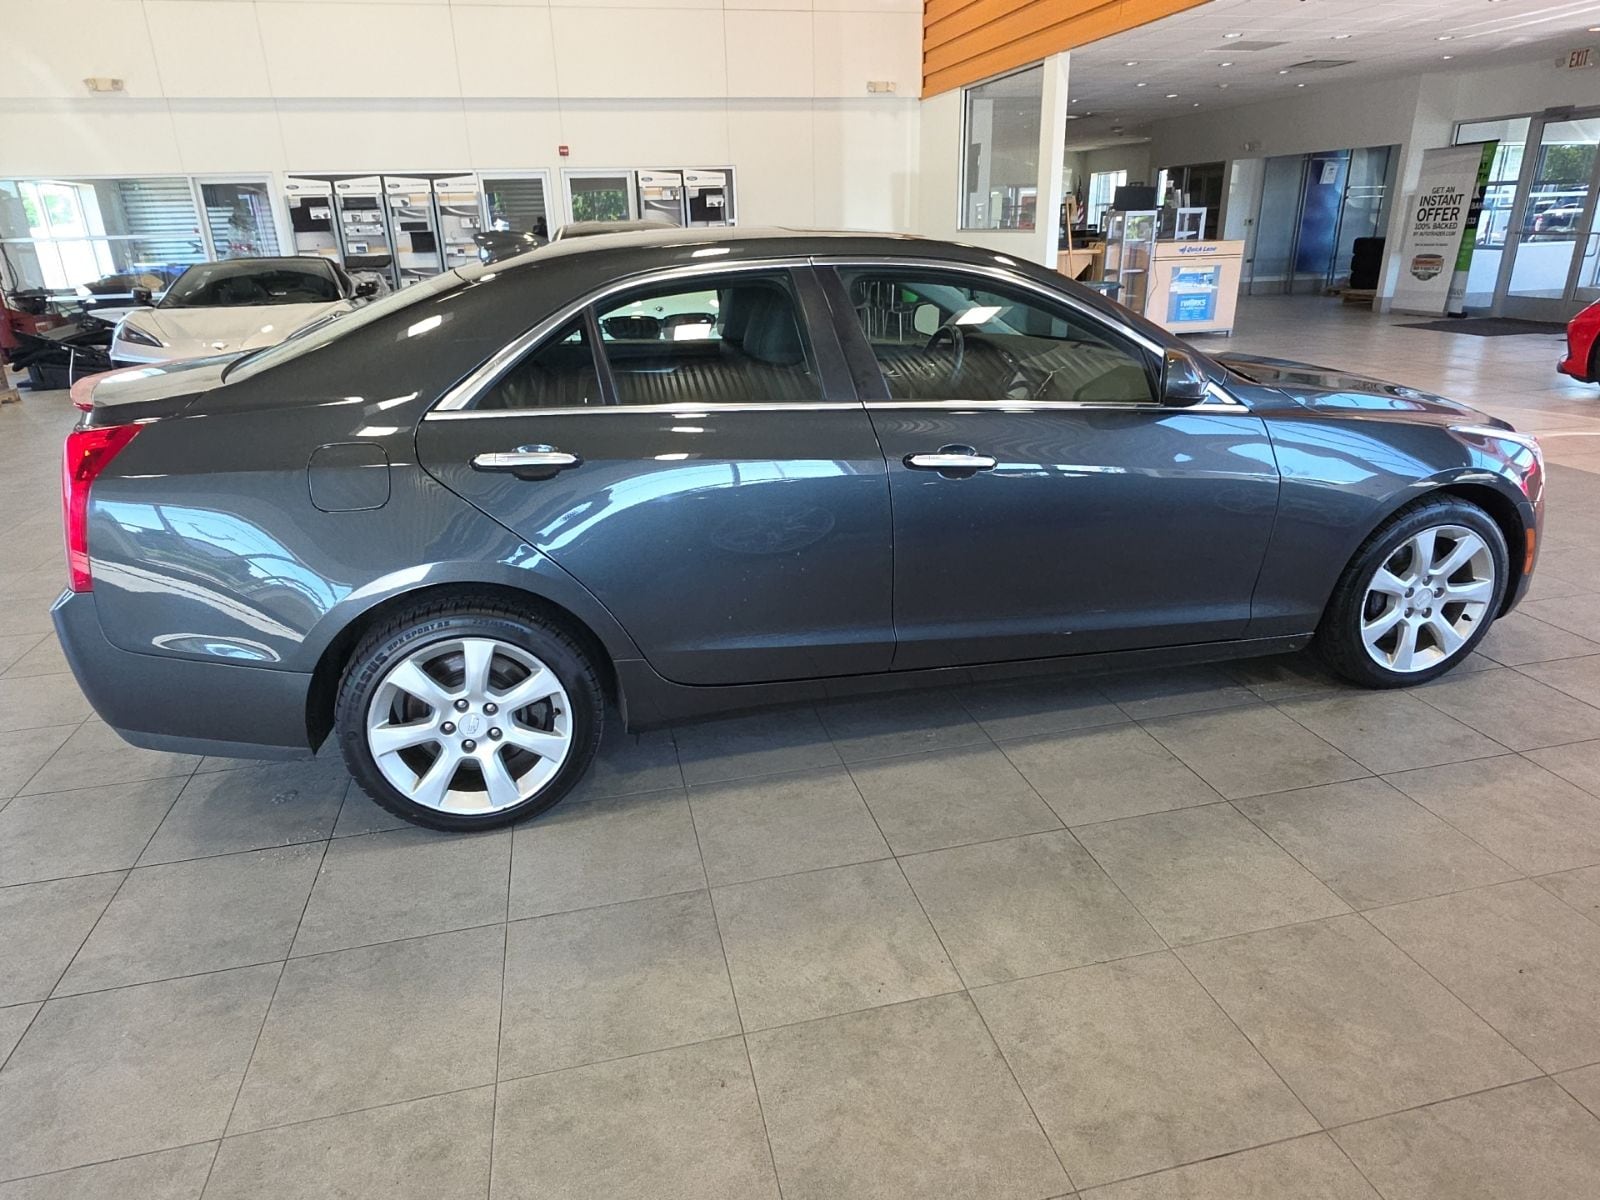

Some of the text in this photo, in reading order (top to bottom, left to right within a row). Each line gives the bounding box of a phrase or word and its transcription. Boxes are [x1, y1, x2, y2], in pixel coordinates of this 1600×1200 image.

[1569, 49, 1590, 68] EXIT
[1445, 185, 1456, 193] AN
[1420, 194, 1464, 206] INSTANT
[1417, 207, 1459, 222] OFFER
[1432, 222, 1458, 230] BACKED
[405, 624, 435, 639] SPORT
